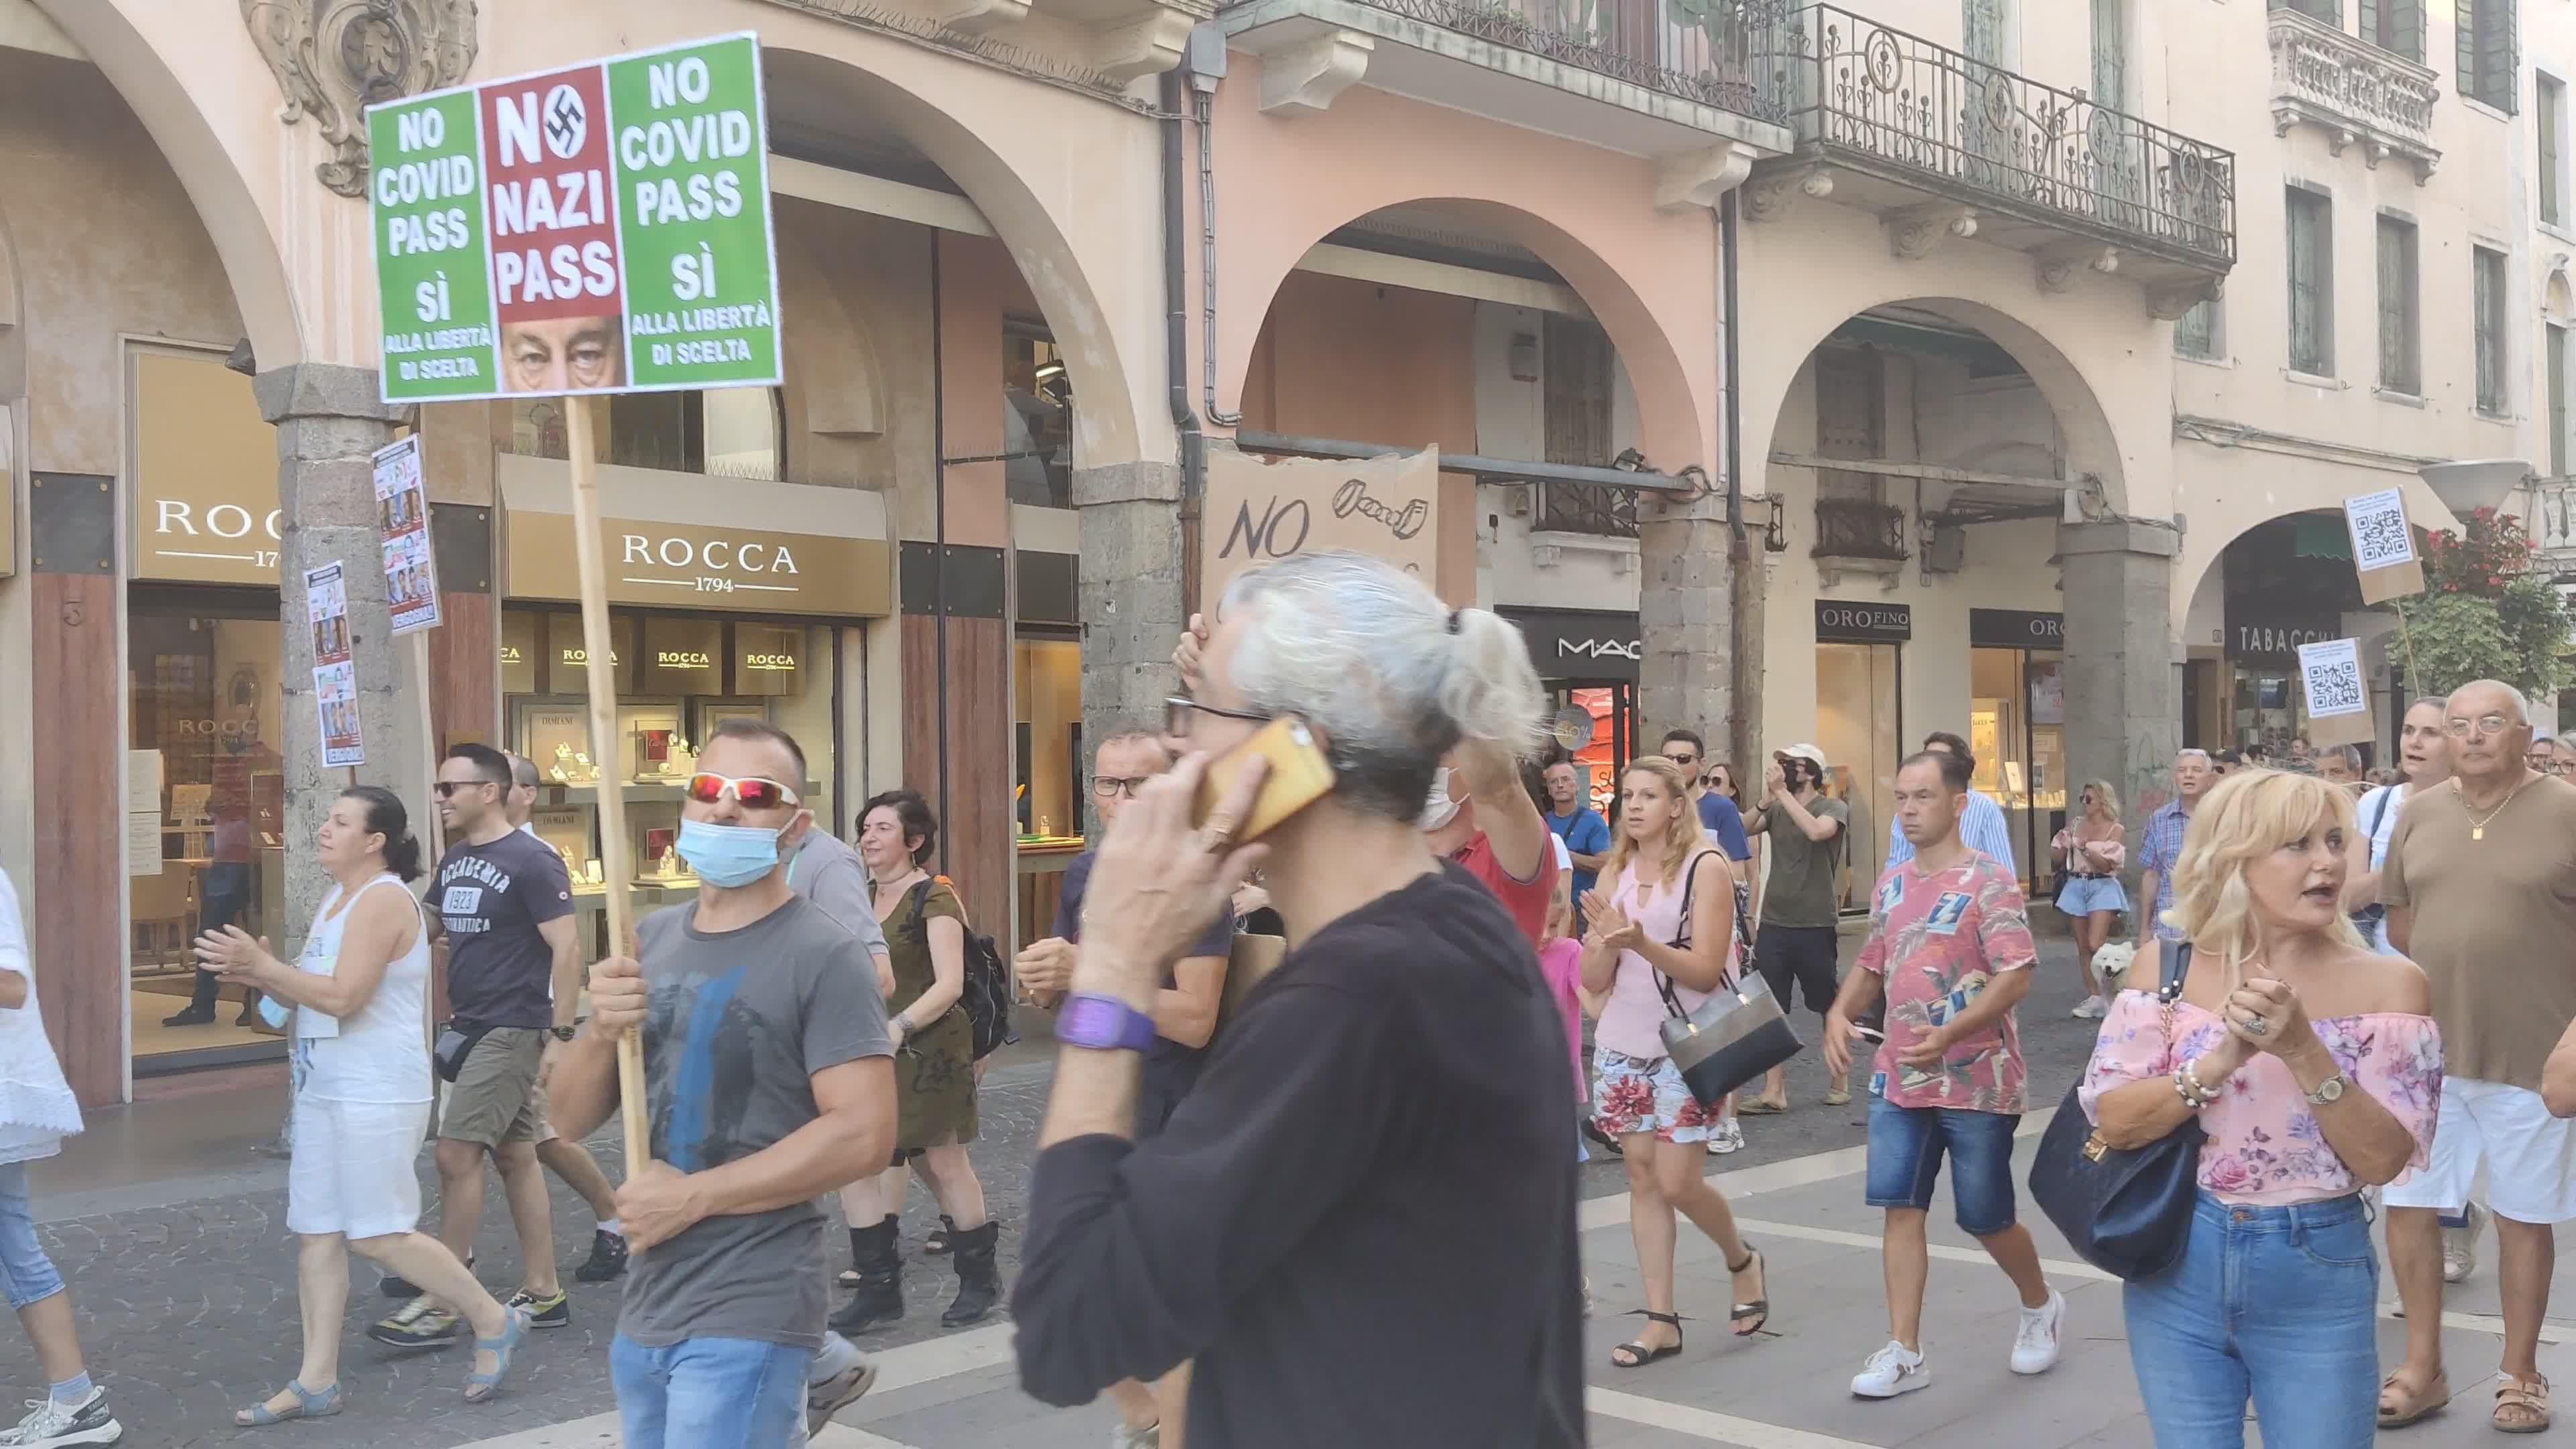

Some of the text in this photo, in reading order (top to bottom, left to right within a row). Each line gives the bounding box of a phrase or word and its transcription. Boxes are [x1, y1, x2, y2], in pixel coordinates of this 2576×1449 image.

[648, 57, 710, 109] NO
[398, 108, 445, 152] NO
[621, 110, 751, 170] COVID
[377, 156, 475, 207] COVID
[494, 169, 606, 236] NAZI
[636, 170, 743, 226] PASS
[388, 208, 469, 256] PASS
[496, 240, 616, 305] PASS
[672, 241, 716, 301] SÌ
[416, 270, 451, 322] SÌ
[632, 301, 771, 335] ALLA LIBERTÀ
[385, 323, 494, 354] ALLA LIBERTÀ
[651, 338, 752, 366] DI SCELTA
[400, 357, 479, 381] DI SCELTA
[1218, 495, 1309, 558] NO
[254, 550, 280, 568] 17
[622, 534, 798, 574] ROCCA
[695, 576, 734, 593] 1794
[563, 649, 618, 661] ROA
[658, 652, 708, 663] ROCCA
[747, 654, 795, 665] ROCCA
